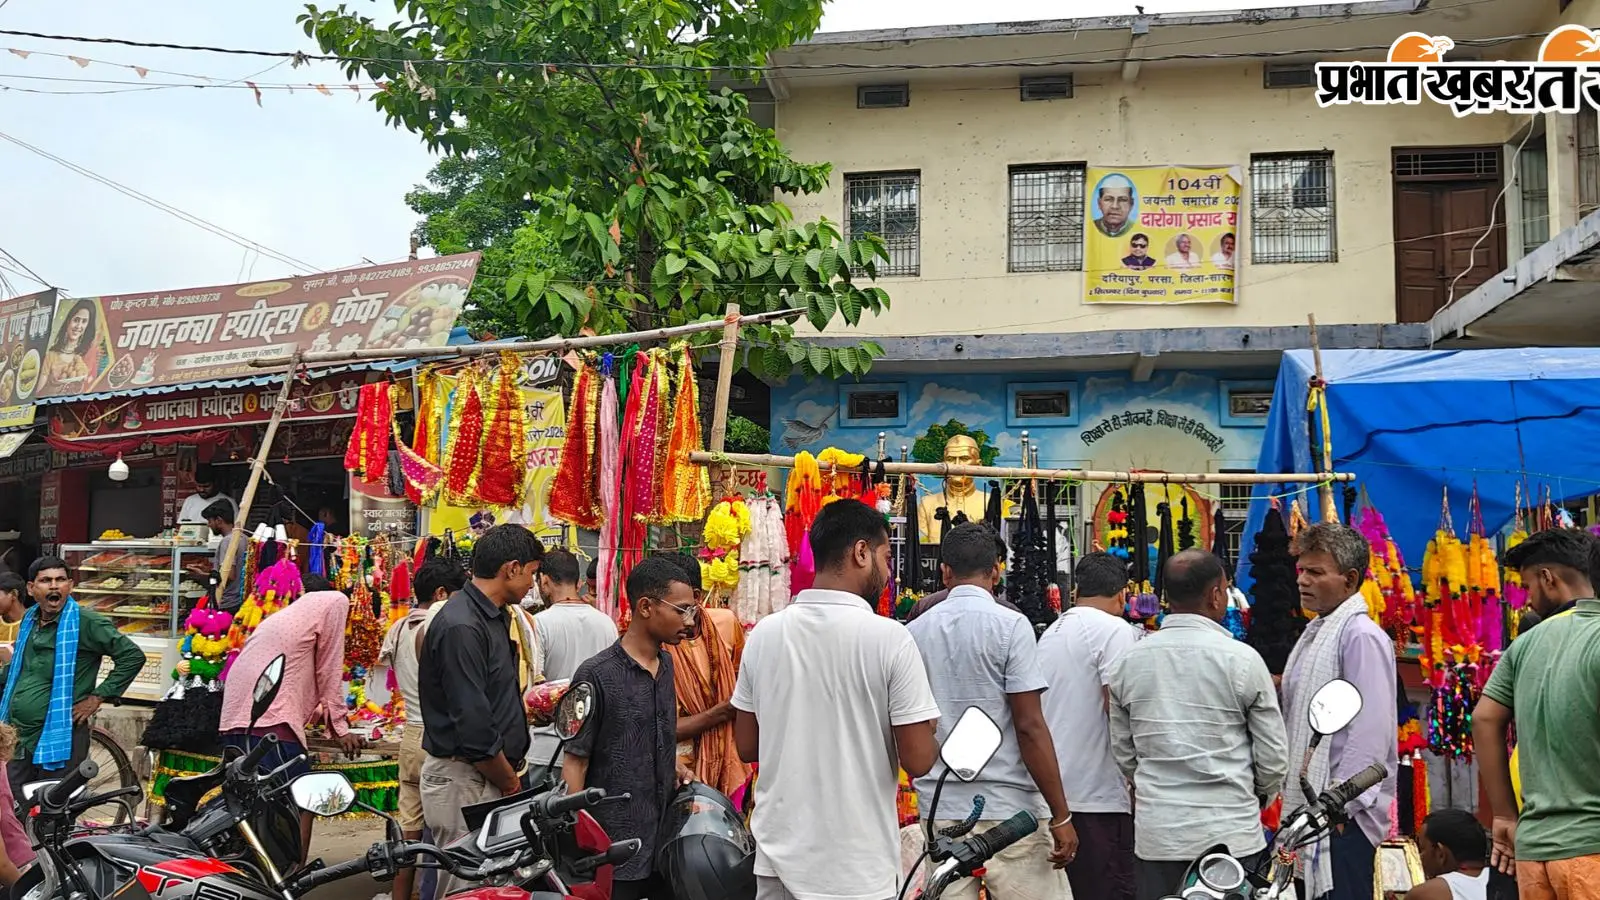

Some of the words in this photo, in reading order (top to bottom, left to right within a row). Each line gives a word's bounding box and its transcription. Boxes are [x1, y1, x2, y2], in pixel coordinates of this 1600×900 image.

[1167, 175, 1222, 191] 104वीं
[1142, 194, 1176, 207] जयन्ती
[1182, 193, 1220, 207] समारोह
[1141, 207, 1184, 228] दारोगा
[1186, 212, 1224, 230] प्रसाद
[117, 312, 223, 351] जगदम्बा
[219, 299, 308, 344] स्वीट्स
[331, 288, 389, 328] केक
[146, 397, 199, 422] जगदम्बा
[201, 390, 244, 420] स्वीट्स
